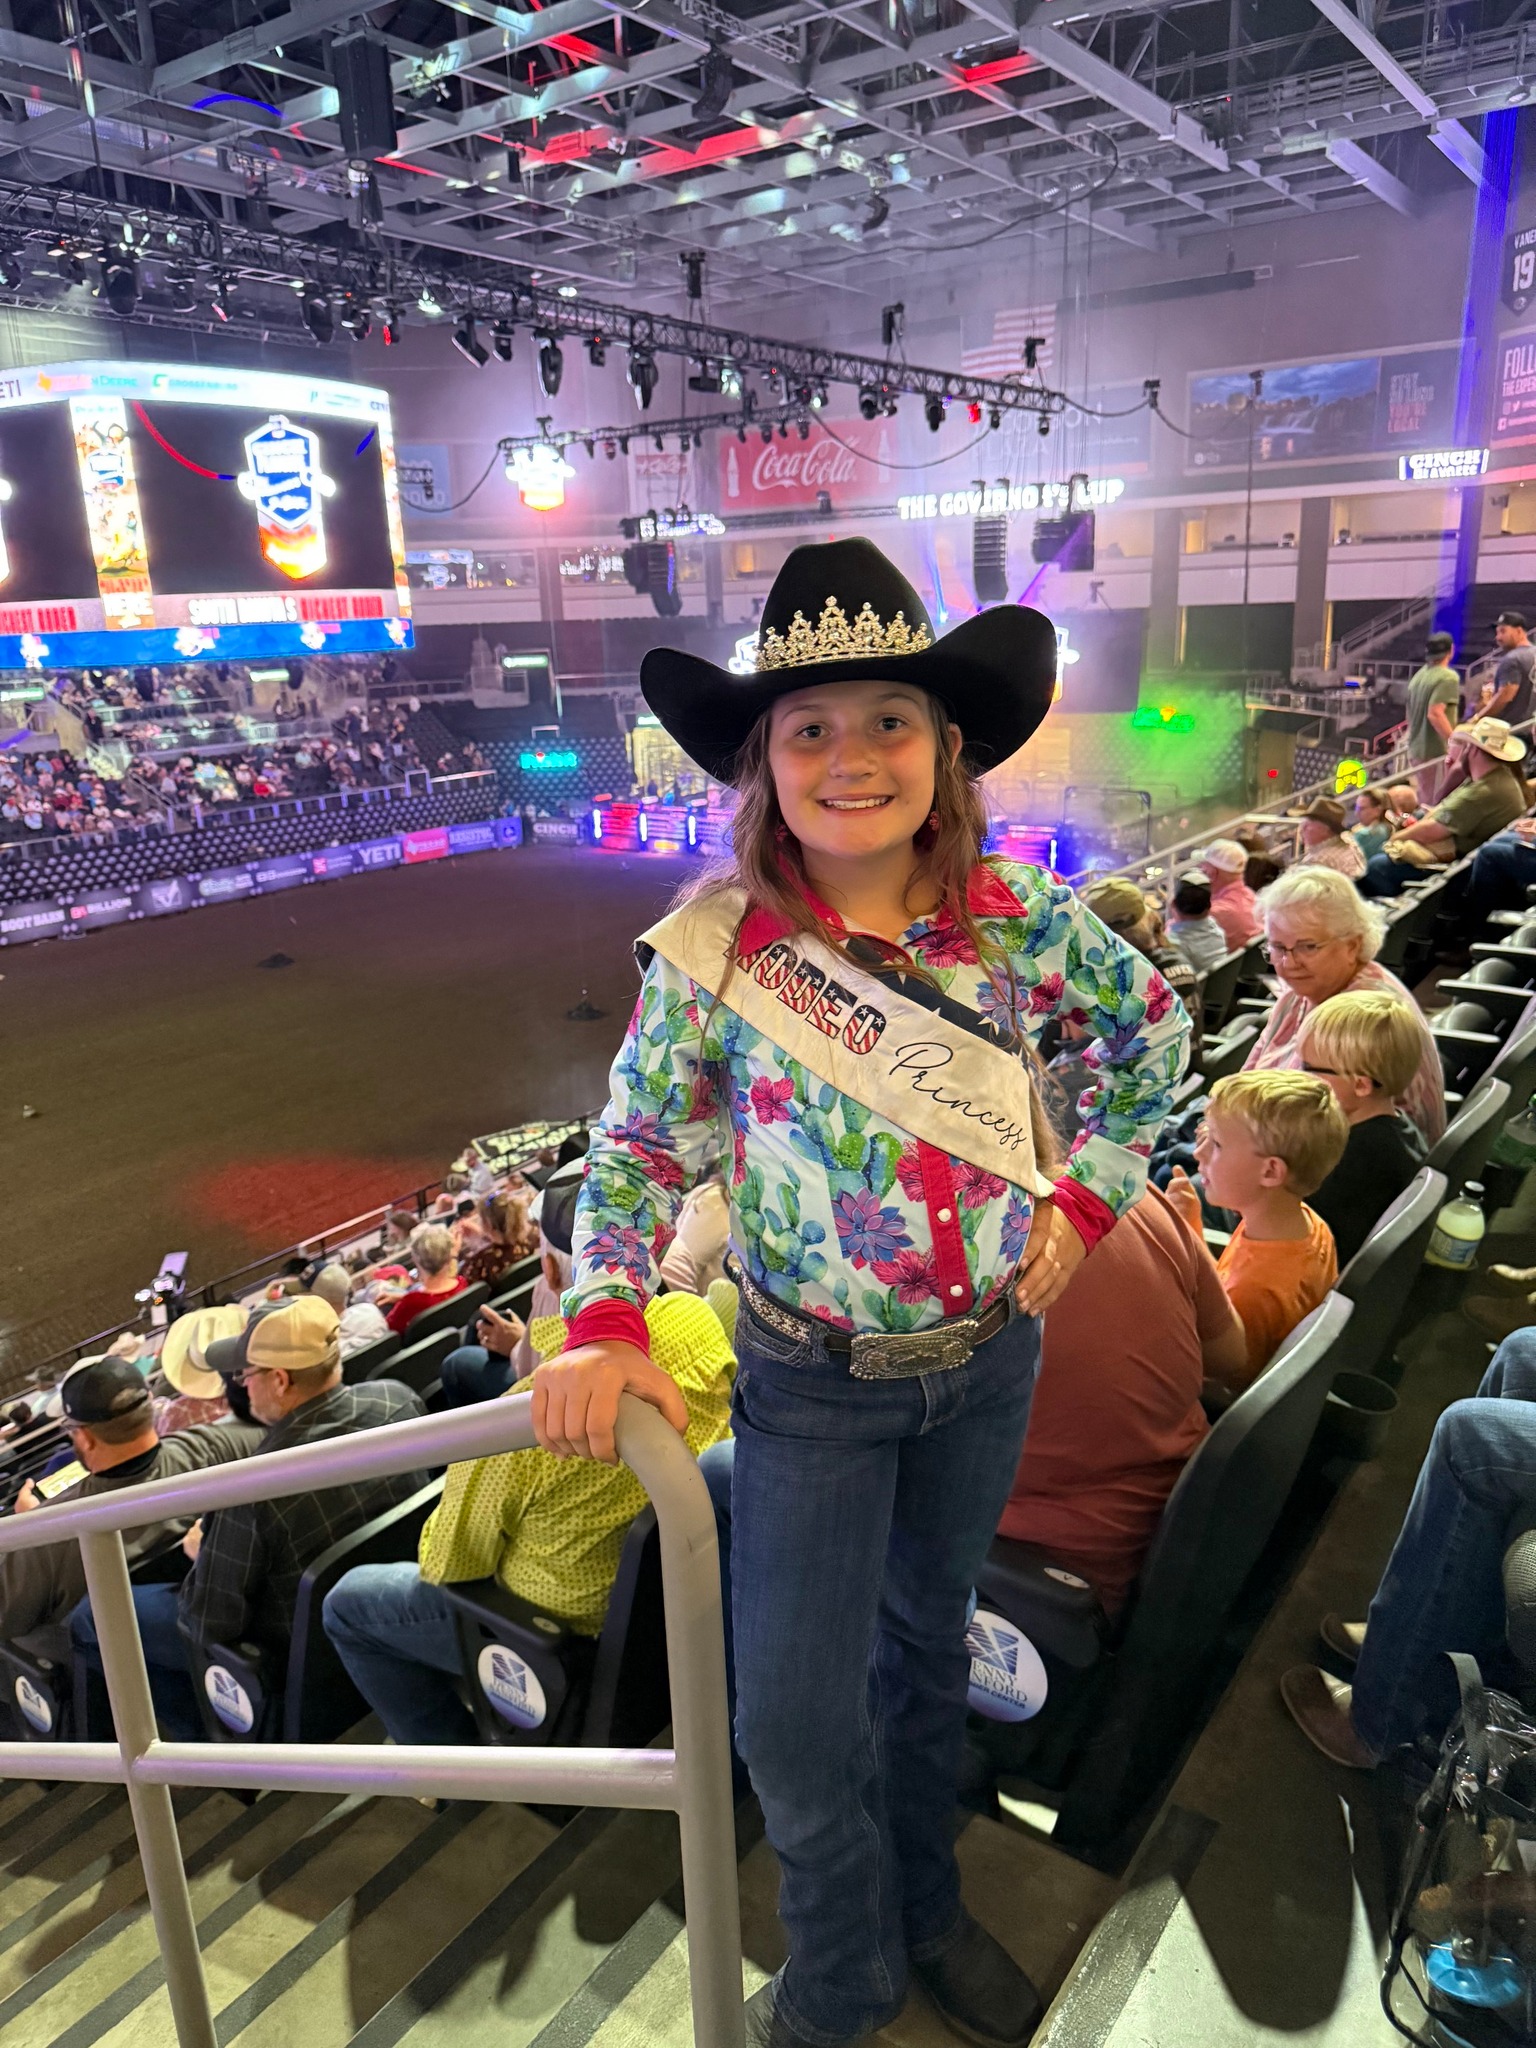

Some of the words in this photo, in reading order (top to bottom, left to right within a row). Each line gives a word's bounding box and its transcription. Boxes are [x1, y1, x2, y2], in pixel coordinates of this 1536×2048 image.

[1514, 230, 1536, 250] VANE
[1512, 250, 1536, 292] 19
[1503, 344, 1536, 381] FOLL
[0, 378, 22, 399] ETI
[1408, 450, 1481, 469] CINCH
[897, 493, 938, 520] THE
[533, 822, 578, 836] CINCH
[359, 841, 400, 866] YETI
[1, 916, 33, 934] BOOT
[889, 1042, 1027, 1150] Princess
[972, 1659, 1018, 1687] ENNY
[972, 1670, 1028, 1703] NFORD
